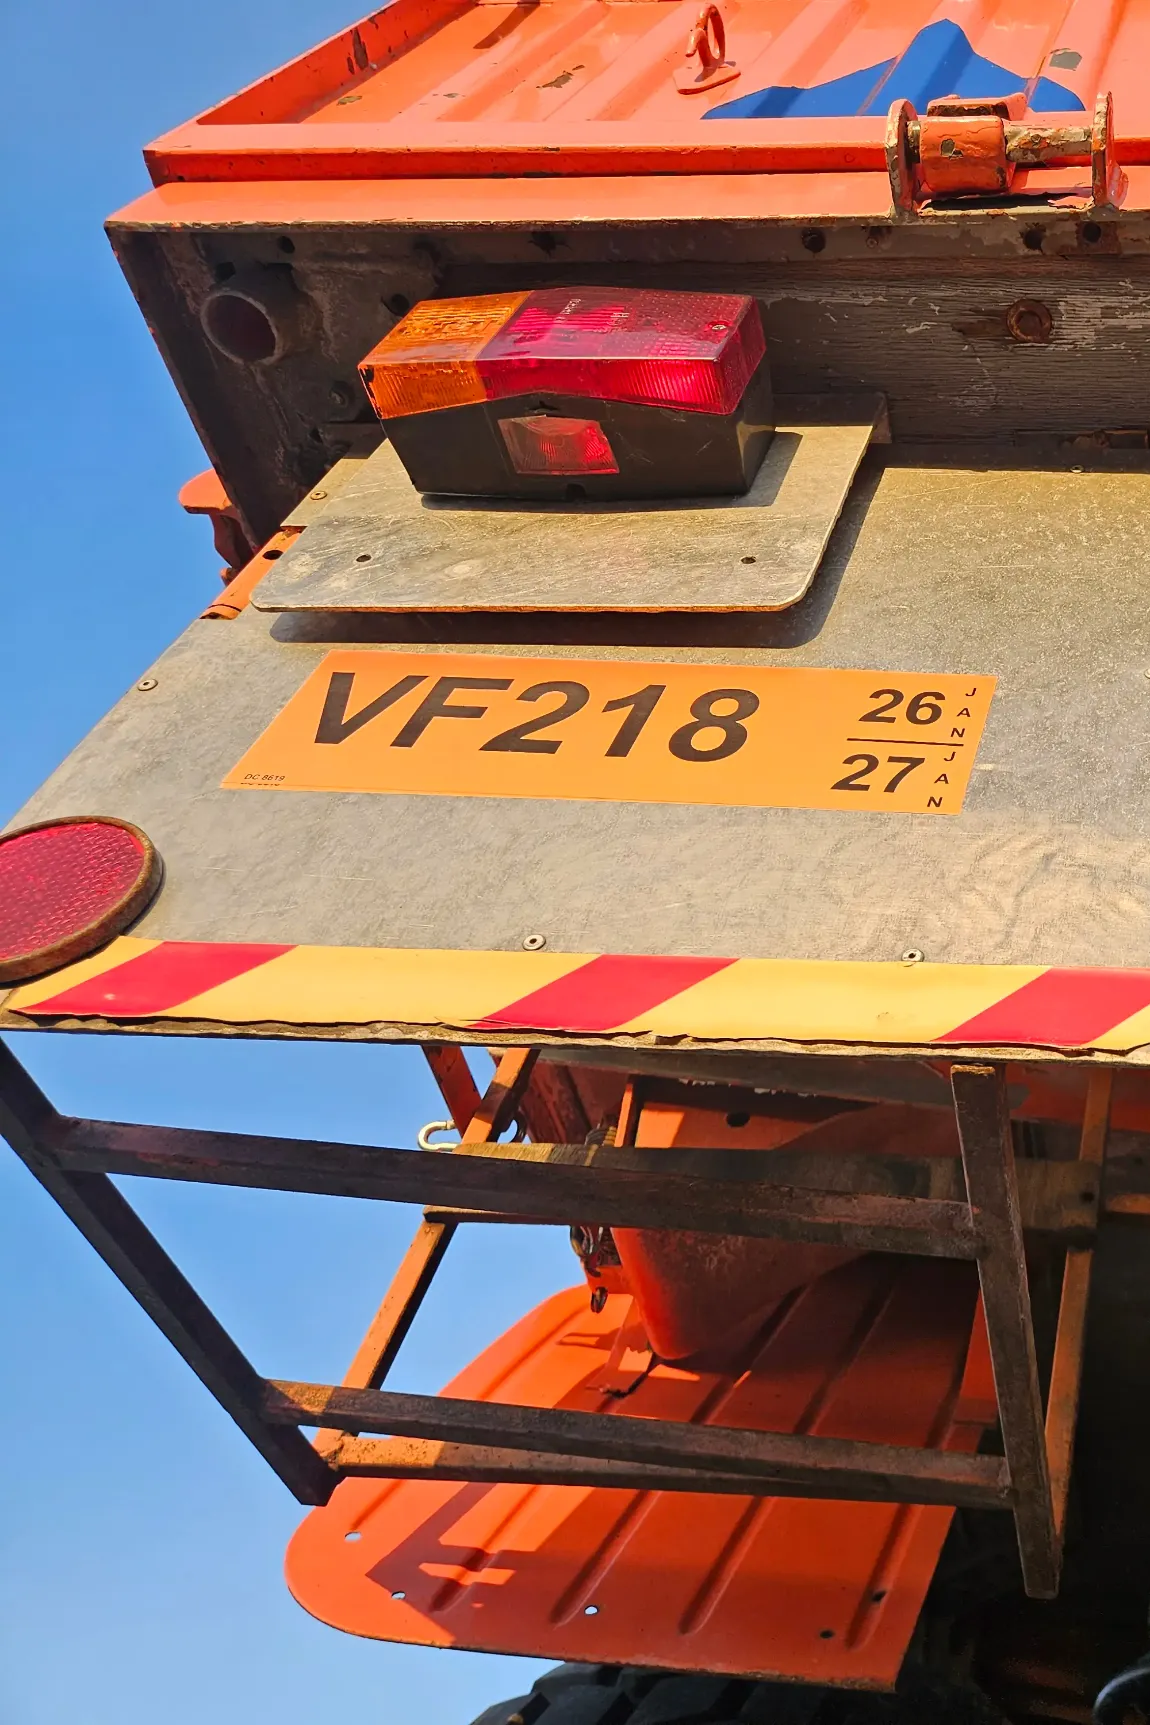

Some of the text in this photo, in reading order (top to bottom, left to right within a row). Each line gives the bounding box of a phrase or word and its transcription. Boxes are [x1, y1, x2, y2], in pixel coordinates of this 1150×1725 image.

[314, 672, 760, 763] VF218
[858, 688, 946, 726] 26
[950, 687, 977, 738] JAN
[830, 753, 926, 793] 27
[927, 751, 956, 808] JAN
